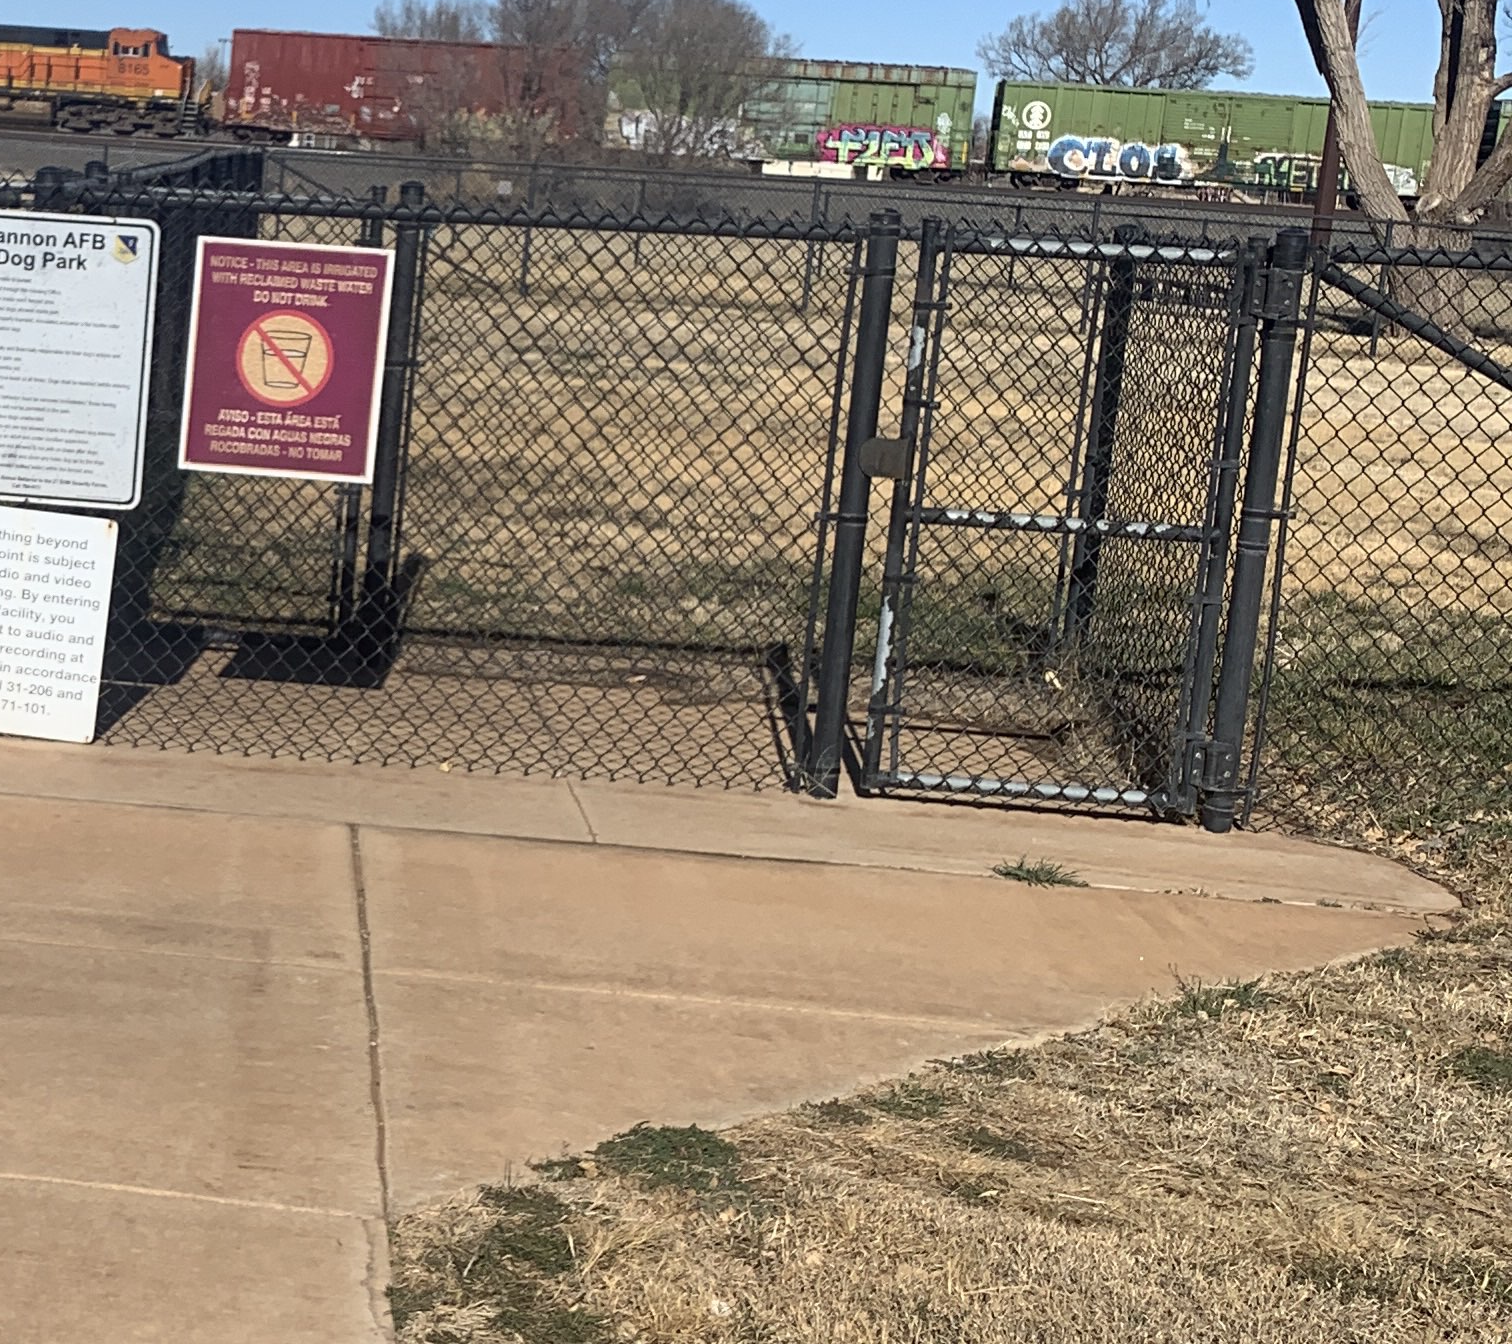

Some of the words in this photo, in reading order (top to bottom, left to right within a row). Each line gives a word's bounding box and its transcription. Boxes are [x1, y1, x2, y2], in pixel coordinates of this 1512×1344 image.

[63, 232, 106, 250] AFB
[42, 252, 88, 270] Park
[210, 256, 248, 269] NOTICE
[256, 258, 279, 271] THIS
[281, 260, 309, 273] AREA
[311, 262, 321, 274] IS
[323, 263, 378, 278] IRRIGATED
[211, 272, 238, 285] WITH
[239, 273, 298, 289] RECLAIMED
[300, 278, 335, 292] WASTE
[338, 280, 373, 294] WATER
[253, 290, 270, 303] DO
[271, 292, 292, 305] NOT
[218, 409, 249, 423] AVISO
[257, 412, 283, 425] ESTA
[204, 424, 246, 438] REGADA
[248, 427, 271, 440] CON
[272, 430, 307, 443] AGUAS
[310, 432, 351, 447] NEGRAS
[289, 447, 304, 458] NO
[307, 448, 343, 462] TOMAR
[37, 534, 88, 550] beyond
[28, 553, 39, 563] is
[44, 556, 96, 571] subject
[24, 571, 49, 584] and
[54, 575, 91, 589] video
[22, 589, 38, 602] By
[43, 593, 101, 611] entering
[50, 613, 75, 625] you
[8, 626, 21, 637] to
[25, 628, 64, 642] audio
[69, 634, 94, 646] and
[0, 643, 66, 664] recording
[71, 653, 84, 664] at
[0, 663, 10, 673] in
[16, 664, 97, 684] accordance
[7, 681, 53, 697] 31-206
[57, 689, 83, 701] and
